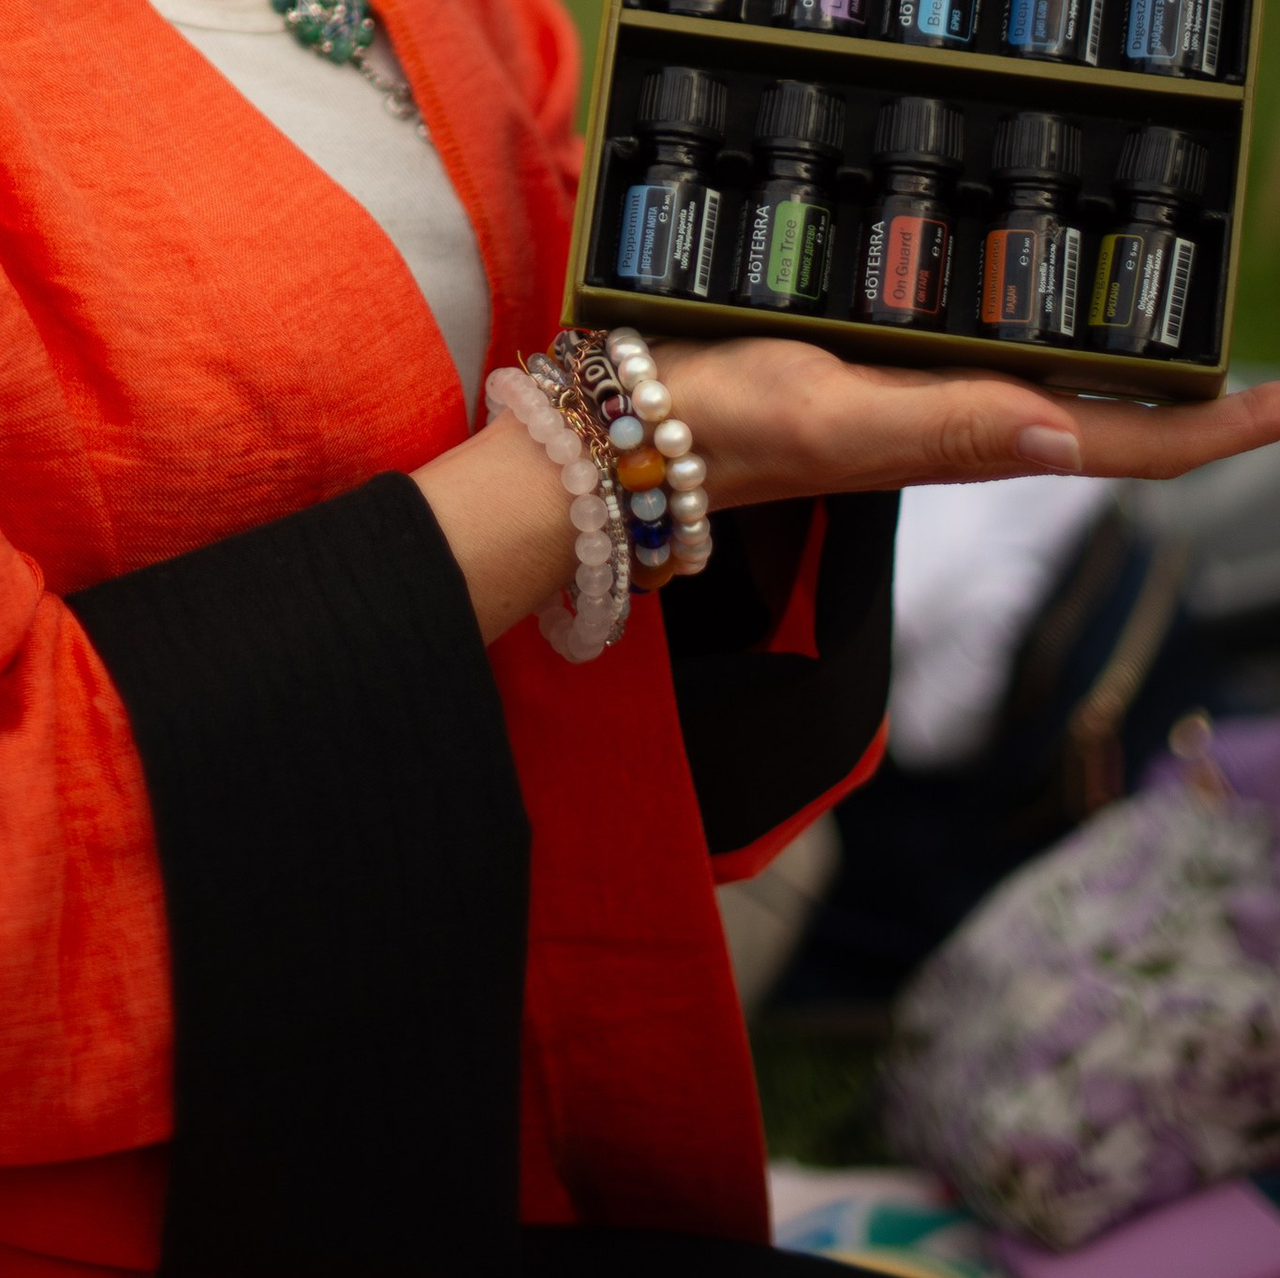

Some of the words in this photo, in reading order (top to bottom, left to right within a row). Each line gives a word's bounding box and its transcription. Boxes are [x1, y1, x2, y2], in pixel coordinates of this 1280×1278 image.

[1013, 2, 1030, 37] Deep
[1151, 6, 1165, 50] ДАЙДЖЕСТ
[1191, 33, 1200, 51] 100%
[622, 194, 641, 268] Peppermint
[646, 206, 658, 228] МЯТА
[676, 208, 688, 234] piperita
[641, 229, 655, 269] ПЕРЕЧНАЯ
[673, 234, 684, 260] Mentha
[747, 205, 770, 283] dōTERRA
[780, 219, 797, 252] Tree
[803, 224, 816, 255] ДЕРЕВО
[680, 251, 689, 270] 100%
[865, 221, 885, 299] dōTERRA
[895, 231, 913, 276] Guard
[1142, 253, 1154, 278] vulgare
[775, 258, 792, 284] Tea
[799, 255, 812, 288] ЧАЙНОЕ
[987, 237, 1000, 314] Frankincense
[1090, 251, 1108, 318] Oregano
[892, 280, 907, 300] On
[1005, 284, 1018, 314] ЛАДАН
[1045, 295, 1053, 313] 100%
[1106, 282, 1120, 317] ОРЕГАНО
[1137, 278, 1150, 310] Origanum
[1145, 299, 1155, 318] 100%
